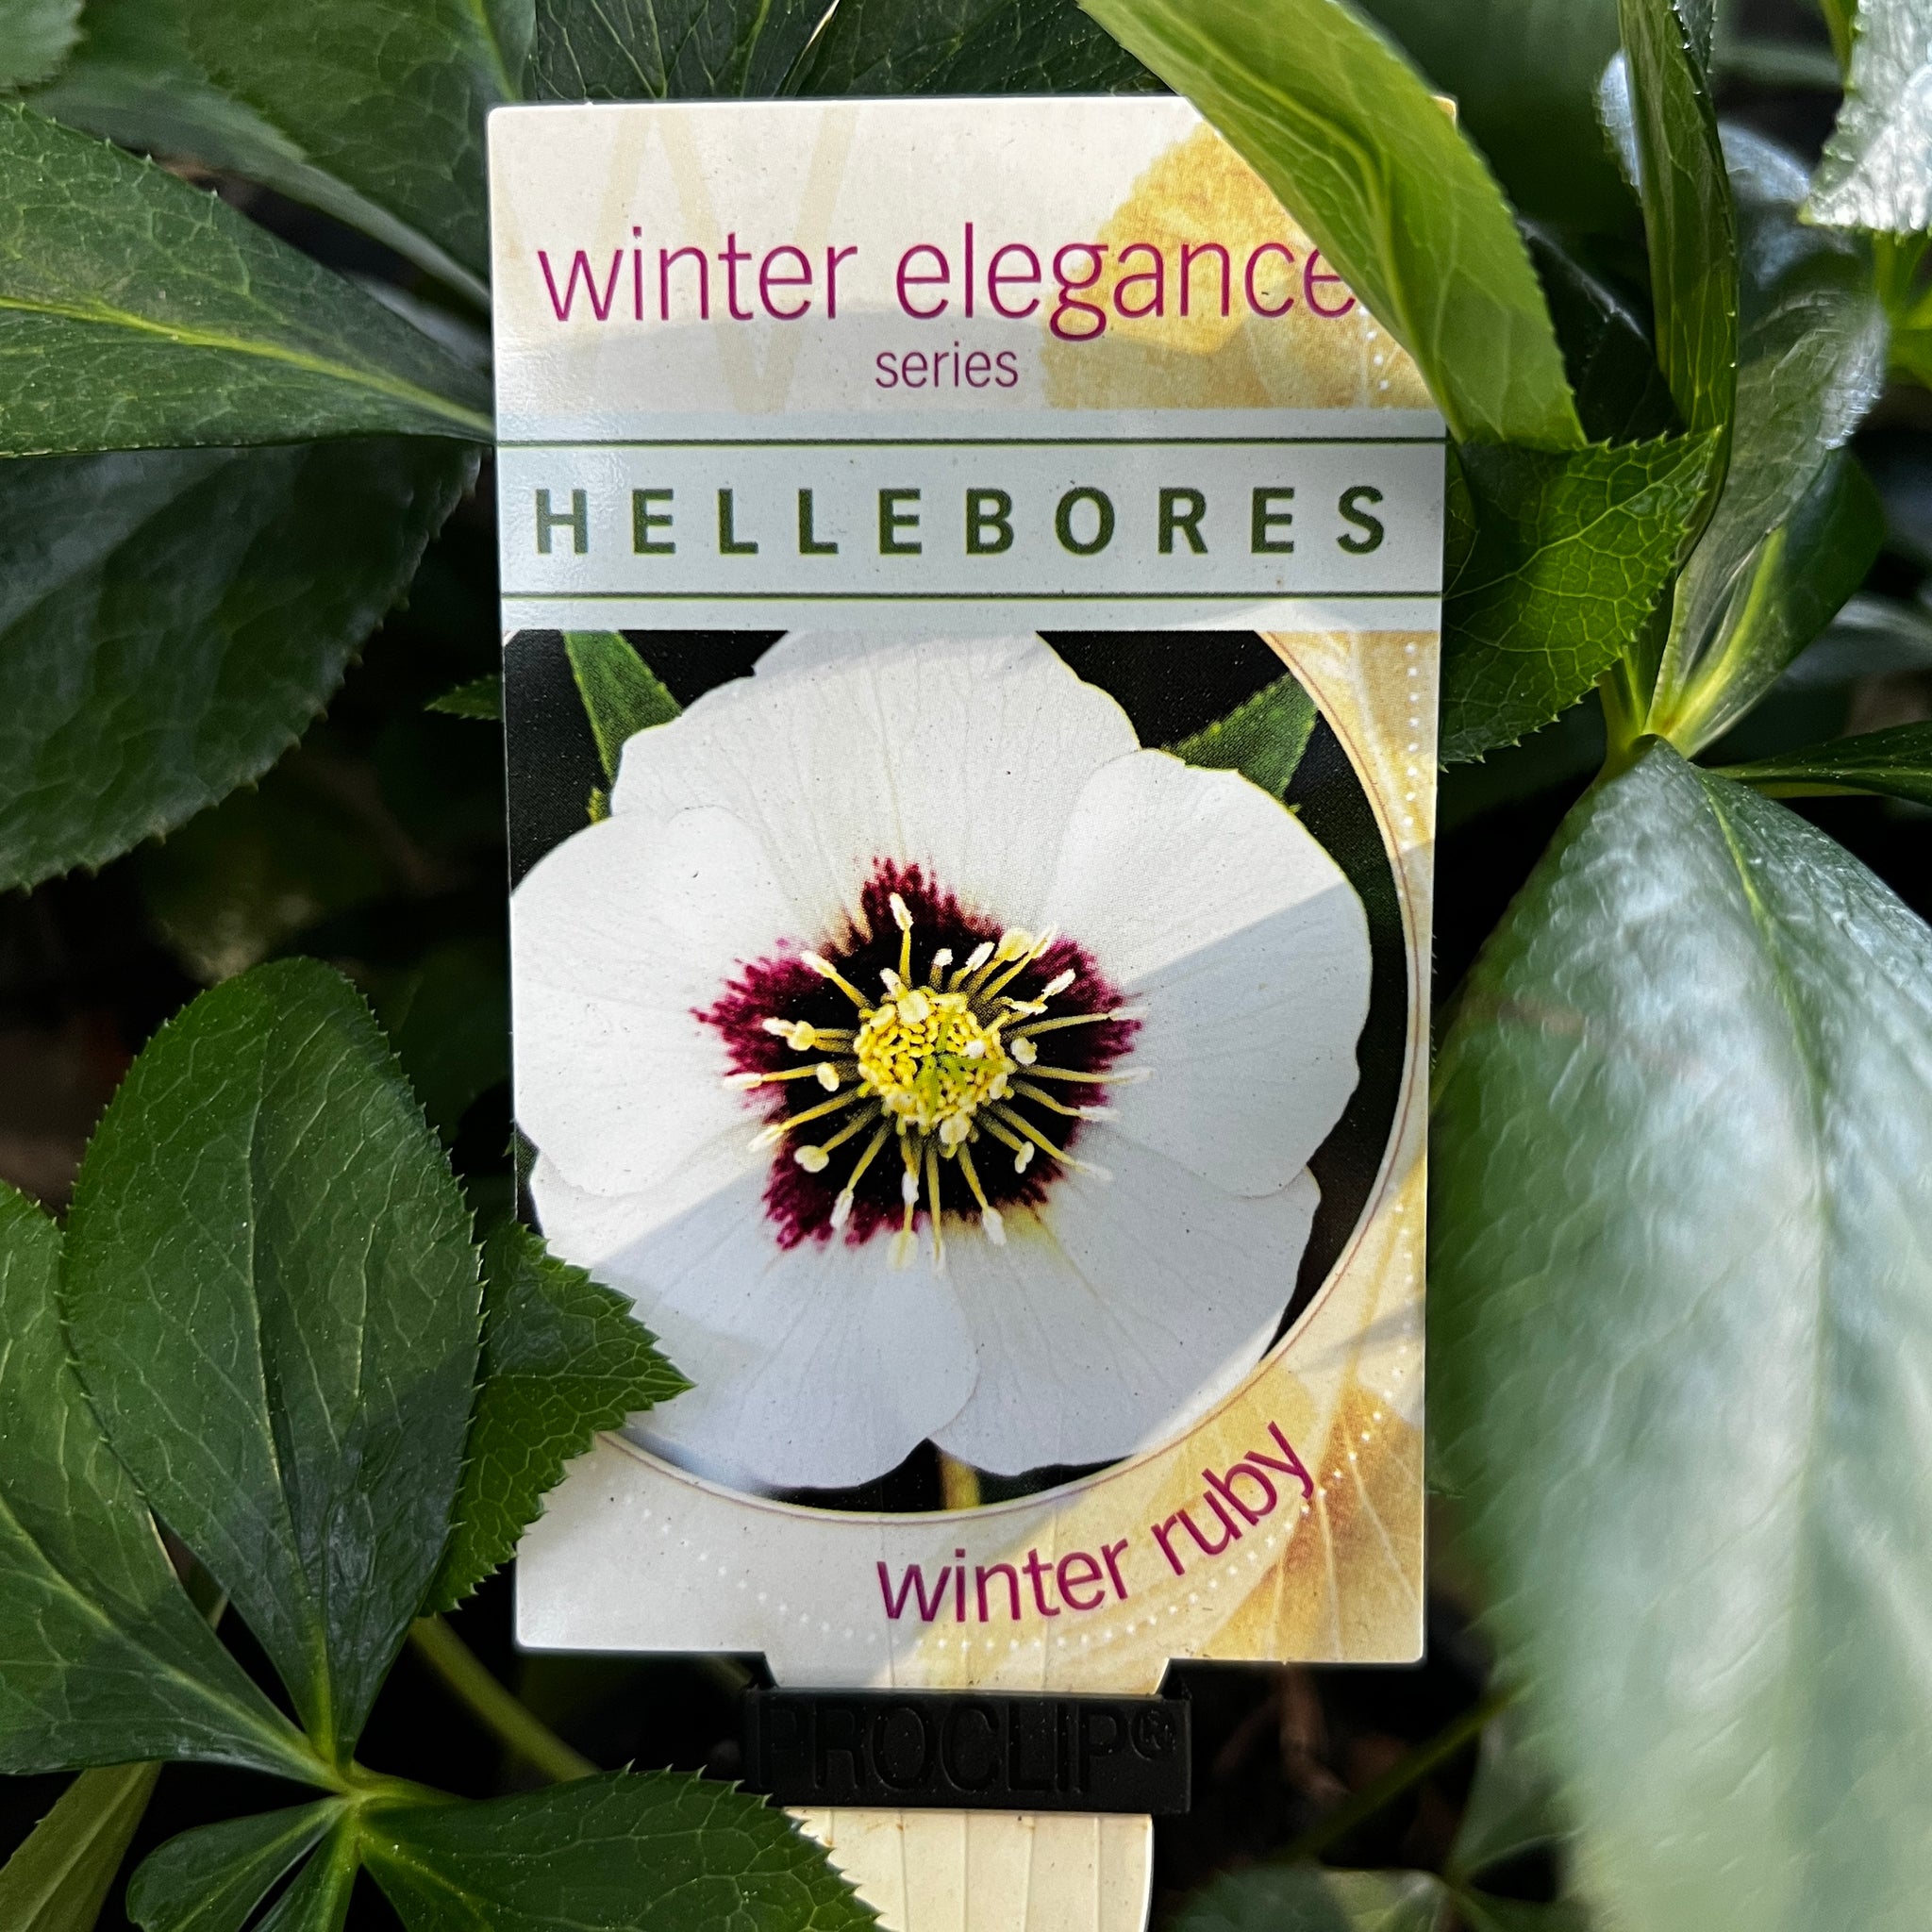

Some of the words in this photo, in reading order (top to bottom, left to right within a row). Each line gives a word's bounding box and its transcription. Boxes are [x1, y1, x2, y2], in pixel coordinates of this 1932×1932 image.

[538, 225, 858, 323] winter
[895, 222, 1357, 341] elegance
[874, 343, 1019, 389] series
[535, 485, 1386, 557] HELLEBORES
[877, 1537, 1129, 1623] winter
[1152, 1422, 1315, 1575] ruby
